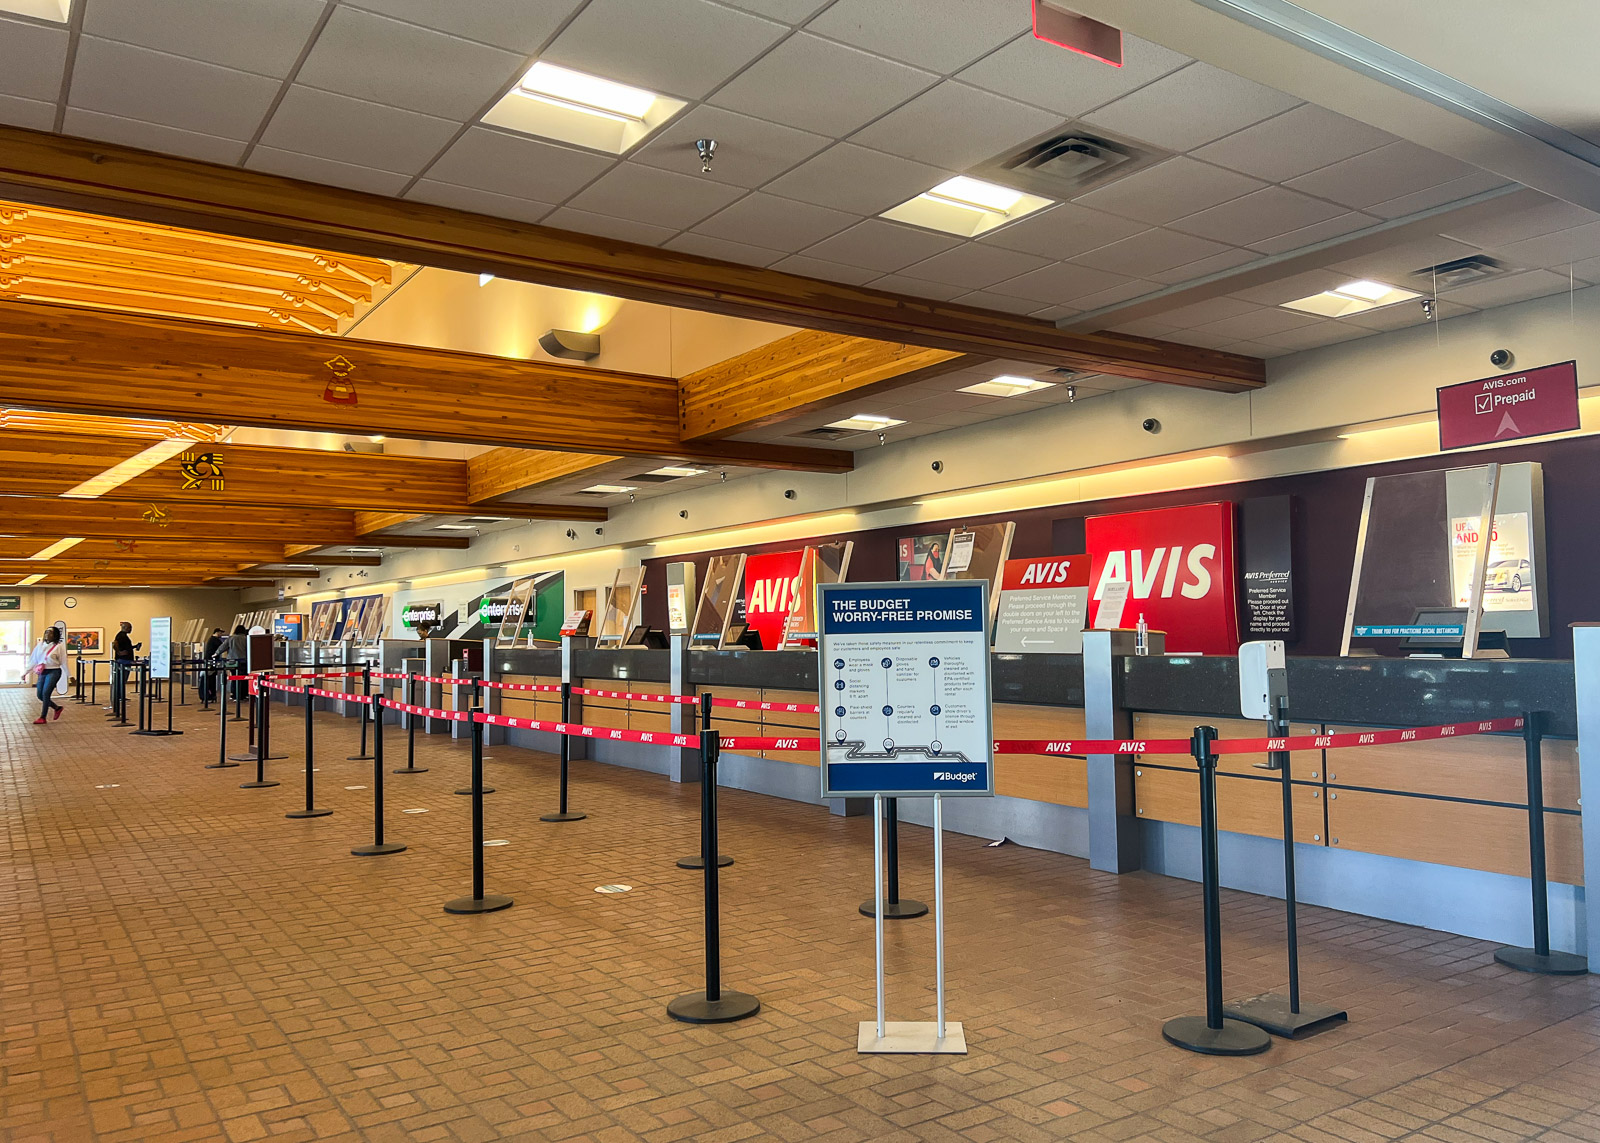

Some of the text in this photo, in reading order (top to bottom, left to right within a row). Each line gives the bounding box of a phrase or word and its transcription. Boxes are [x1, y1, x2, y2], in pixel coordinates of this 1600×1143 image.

[1482, 376, 1526, 390] AVIS.com
[1494, 388, 1536, 406] Prepaid
[1020, 561, 1070, 584] AVIS
[1093, 543, 1216, 600] AVIS
[1259, 570, 1290, 580] Preferred
[748, 576, 803, 613] AVIS
[479, 600, 524, 620] enterprise
[832, 599, 910, 610] THE BUDGET
[401, 608, 436, 623] enterprise
[832, 610, 972, 622] WORRY-FREE PROMISE
[736, 700, 746, 708] AVIS
[786, 704, 797, 712] AVIS
[555, 724, 566, 732] AVIS
[581, 727, 593, 735] AVIS
[610, 730, 622, 739] AVIS
[640, 733, 653, 742] AVIS
[673, 736, 686, 745] AVIS
[1267, 718, 1524, 750] AVIS AVIS AVIS AVIS AVIS AVIS AVI
[719, 738, 799, 748] VIS AVIS
[1045, 742, 1146, 752] AVIS AVIS
[945, 772, 976, 782] Budget
